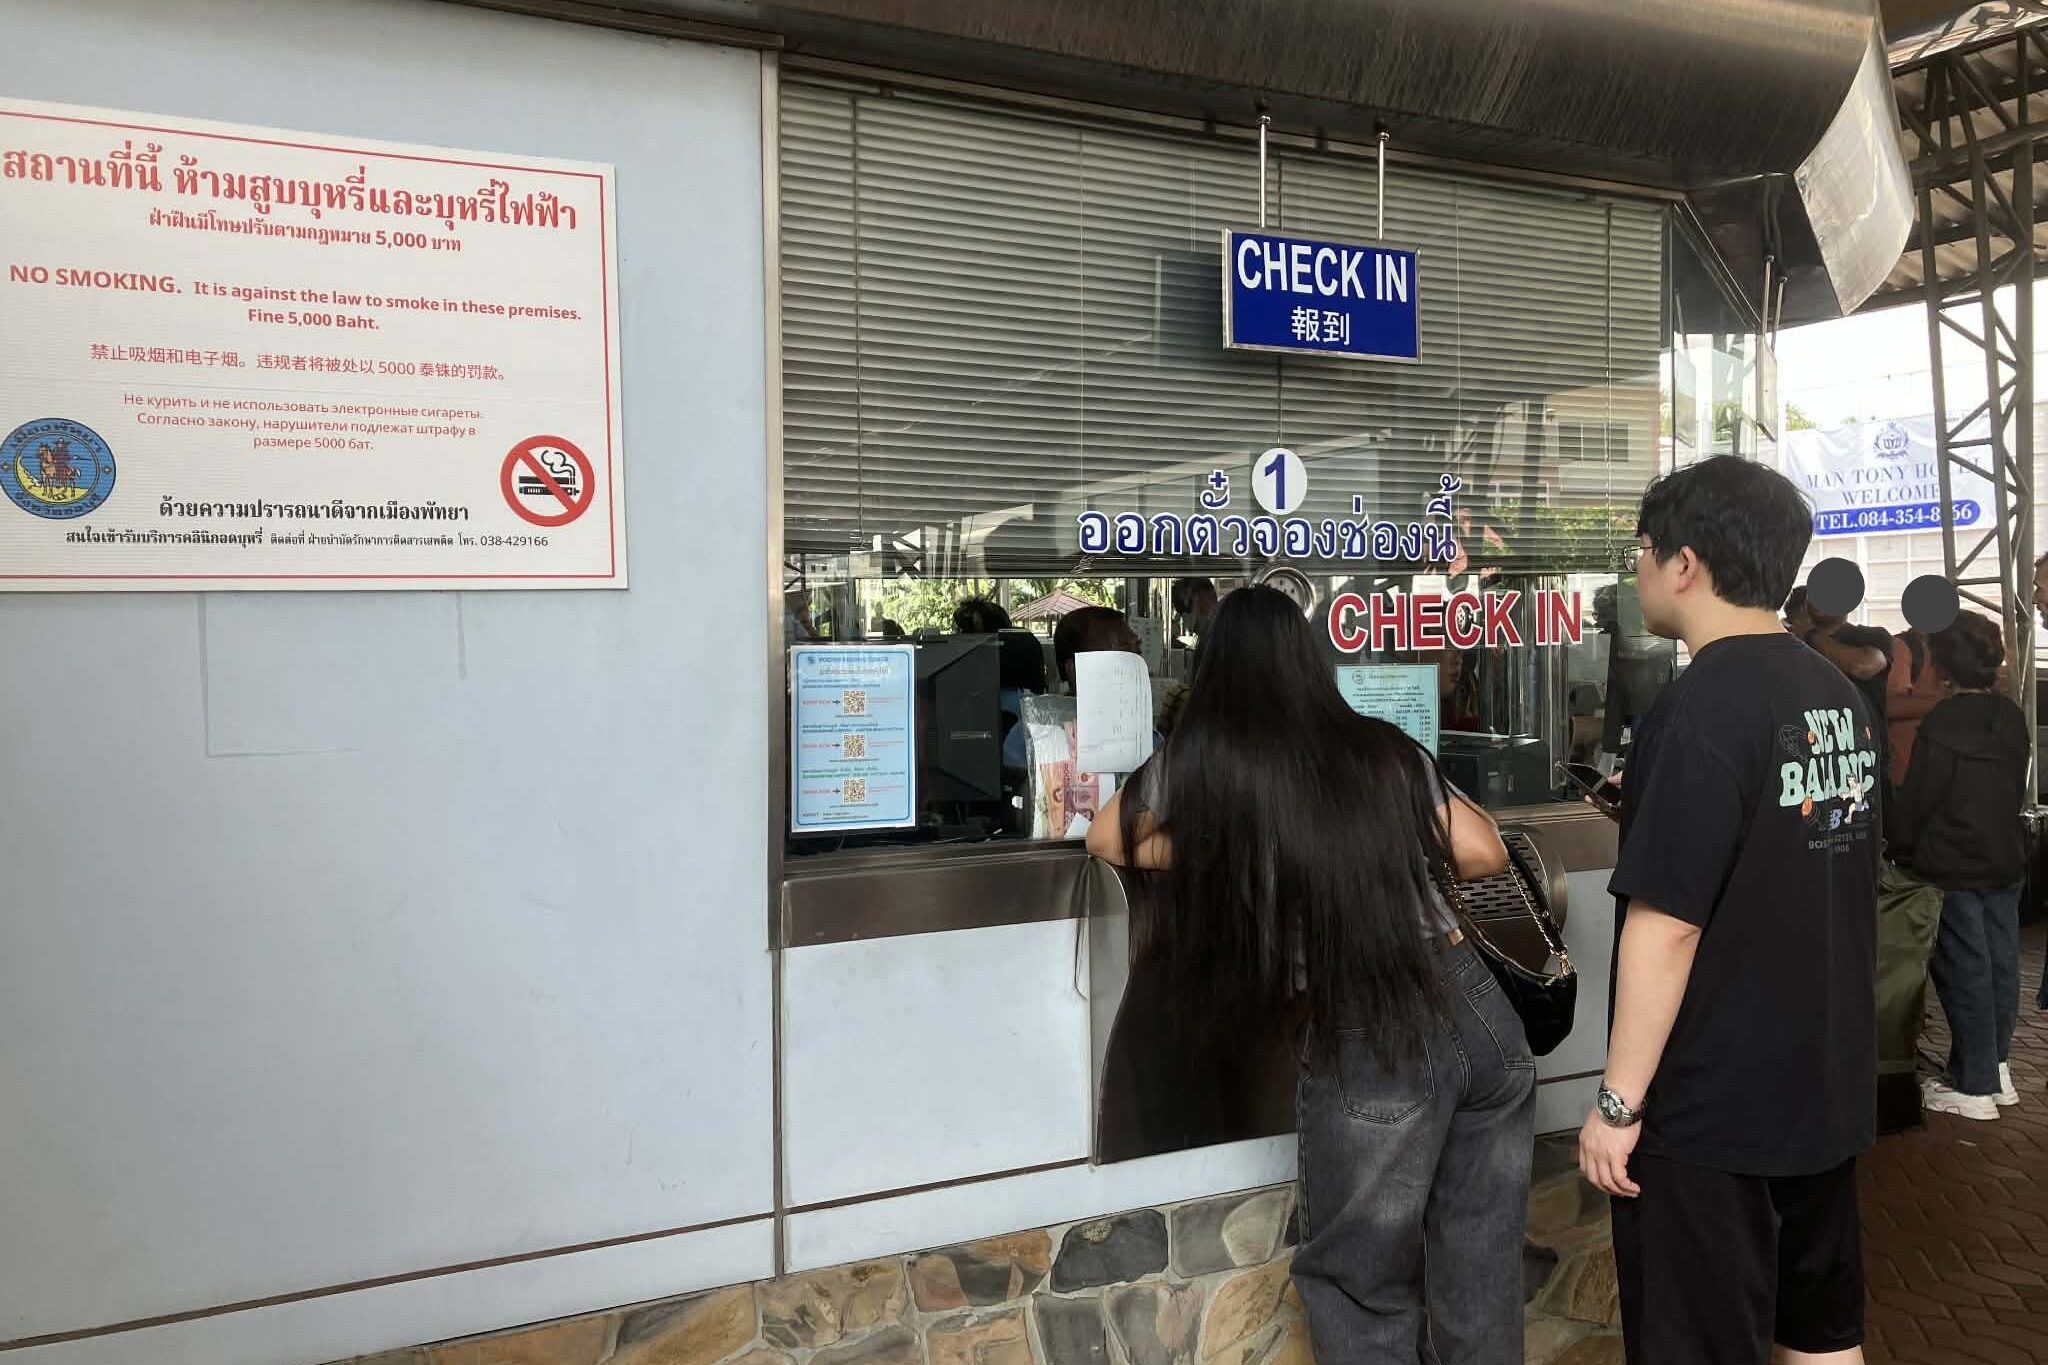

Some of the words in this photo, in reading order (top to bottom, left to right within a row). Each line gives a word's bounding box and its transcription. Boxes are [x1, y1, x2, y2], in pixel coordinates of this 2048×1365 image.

[3, 140, 162, 191] สถานที่นี้
[173, 154, 577, 231] ห้ามสูบบุหรี่และบุหรี่ไฟฟ้า
[375, 232, 427, 249] 5,000
[431, 235, 461, 251] บาท
[1237, 239, 1366, 299] CHECK
[1375, 253, 1408, 303] IN
[9, 264, 49, 284] NO
[55, 268, 182, 294] SMOKING.
[193, 281, 208, 295] It
[213, 282, 226, 296] is
[231, 286, 297, 302] against
[300, 290, 328, 303] the
[332, 291, 361, 306] law
[365, 292, 382, 307] to
[386, 294, 439, 311] smoke
[443, 298, 458, 312] in
[462, 300, 504, 315] these
[508, 303, 582, 320] premises.
[248, 309, 284, 324] Fine
[288, 311, 331, 328] 5,000
[336, 315, 380, 330] Baht.
[1291, 306, 1350, 345] 報到
[379, 361, 415, 375] 5000
[124, 394, 143, 405] Не
[147, 397, 197, 410] курить
[213, 400, 230, 409] не
[233, 401, 328, 413] использовать
[331, 405, 418, 418] электронные
[421, 407, 483, 420] сигареты.
[137, 412, 205, 426] Согласно
[208, 417, 259, 430] закону,
[263, 421, 348, 432] нарушители
[351, 423, 412, 435] подлежат
[416, 427, 466, 438] штрафу
[253, 436, 311, 449] размере
[314, 437, 346, 449] 5000
[350, 438, 374, 450] бат.
[1264, 453, 1286, 510] 1
[1852, 463, 1906, 484] TONY
[160, 495, 469, 520] ด้วยความปรารถนาดีจากเมืองพัทยา
[1842, 484, 1939, 505] WELCOME
[1077, 469, 1462, 562] ออกตั๋วจองช่องนี้
[480, 535, 549, 546] 038-429166
[1328, 590, 1524, 653] CHECK
[1535, 590, 1583, 646] IN
[1804, 707, 1854, 754] NEW
